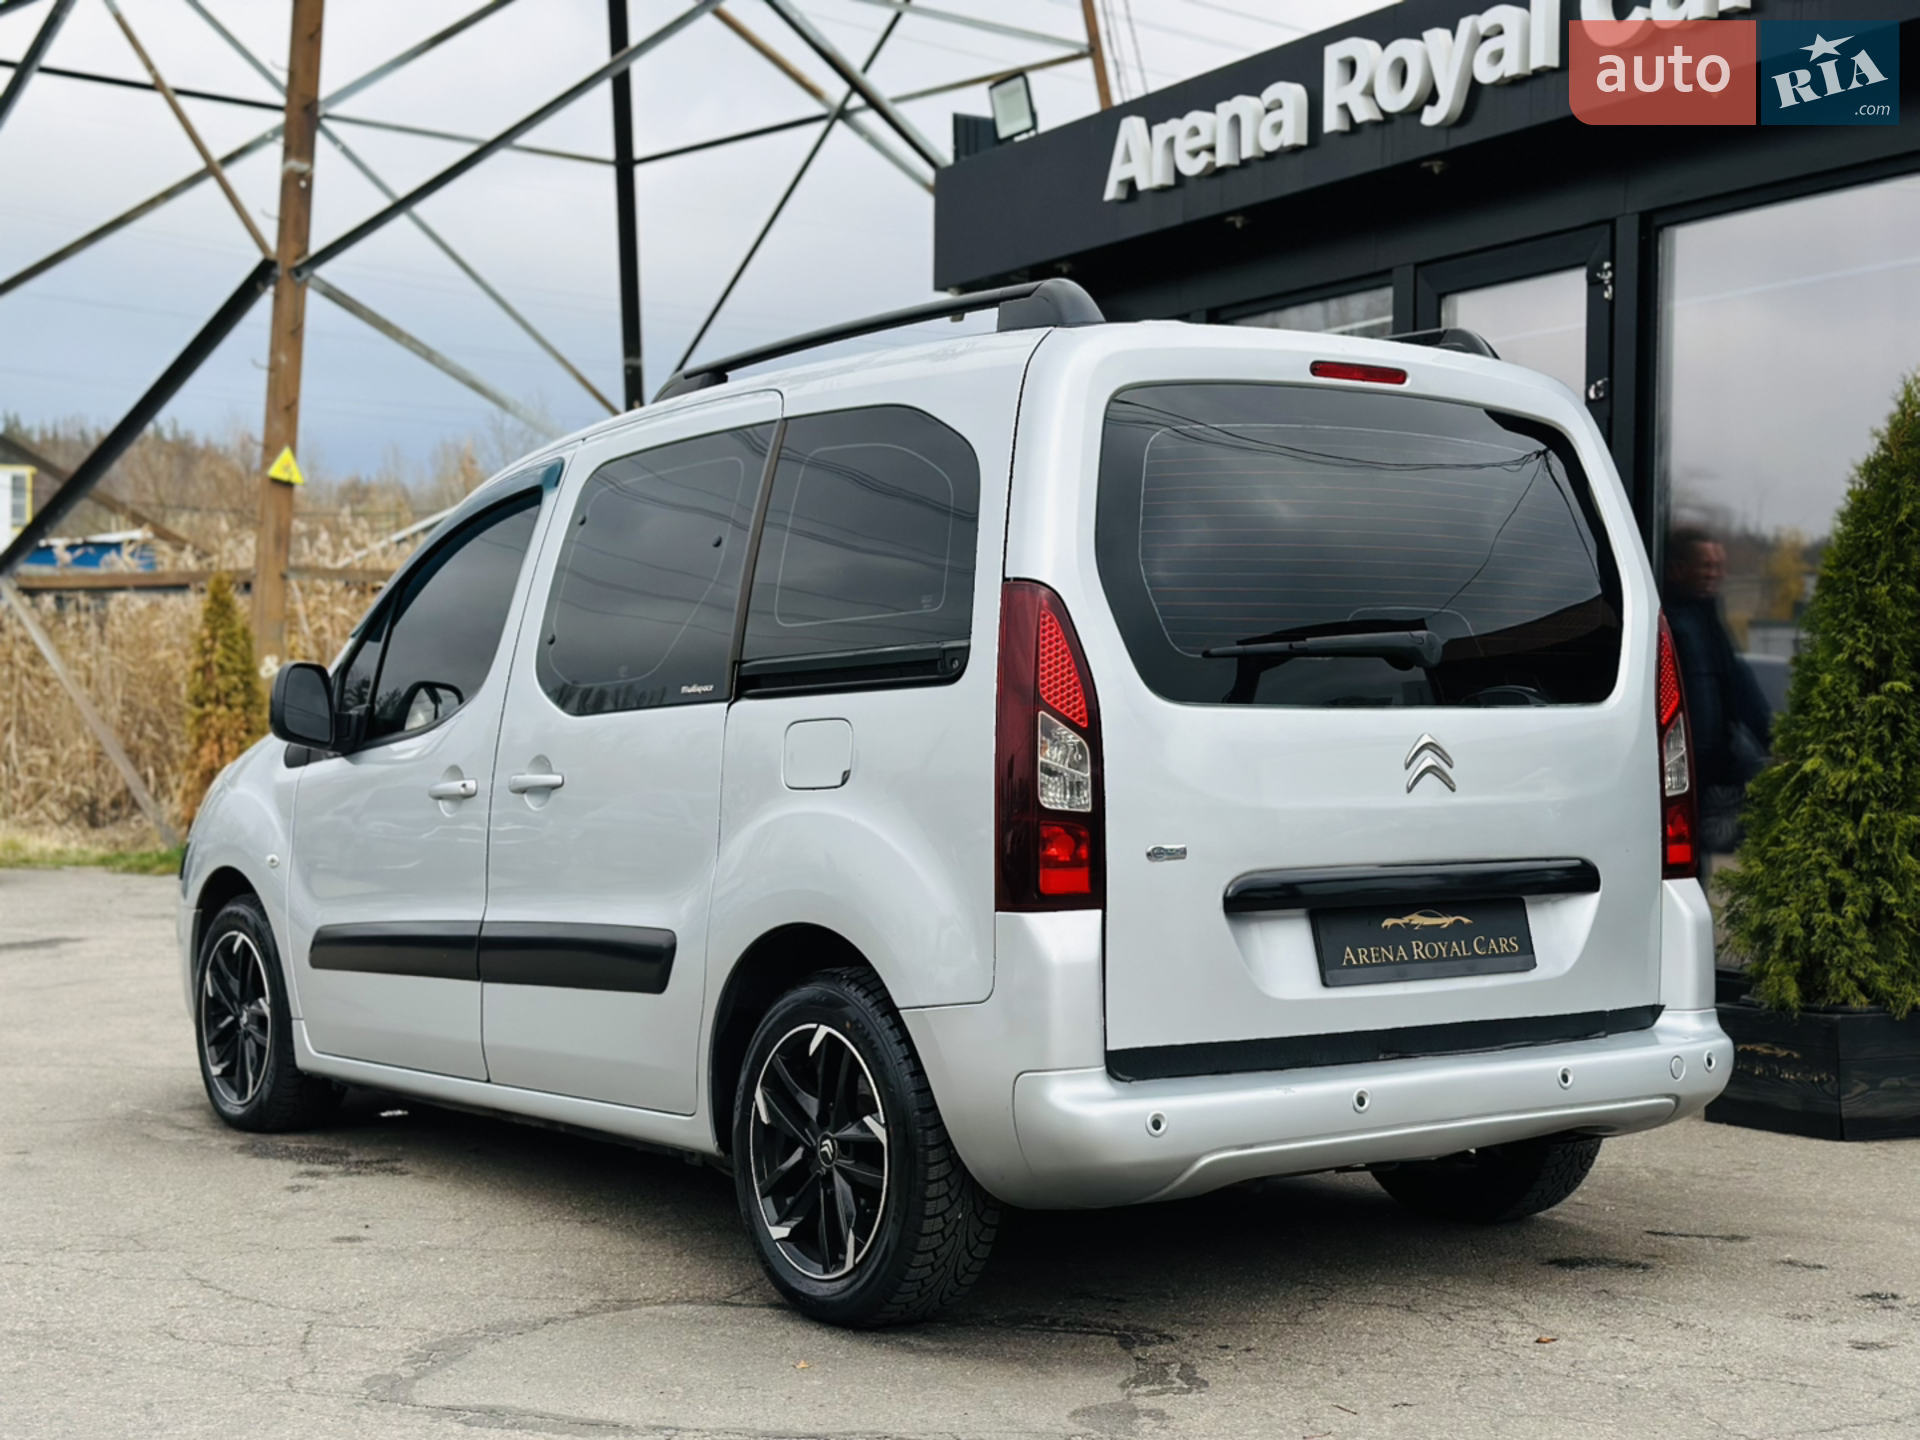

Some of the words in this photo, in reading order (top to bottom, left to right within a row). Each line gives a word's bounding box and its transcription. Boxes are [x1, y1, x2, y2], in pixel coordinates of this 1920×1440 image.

[1103, 80, 1308, 201] Arena
[1323, 0, 1560, 134] Royal
[1341, 945, 1409, 966] ARENA
[1411, 940, 1472, 961] ROYAL
[1473, 935, 1520, 955] CARS
